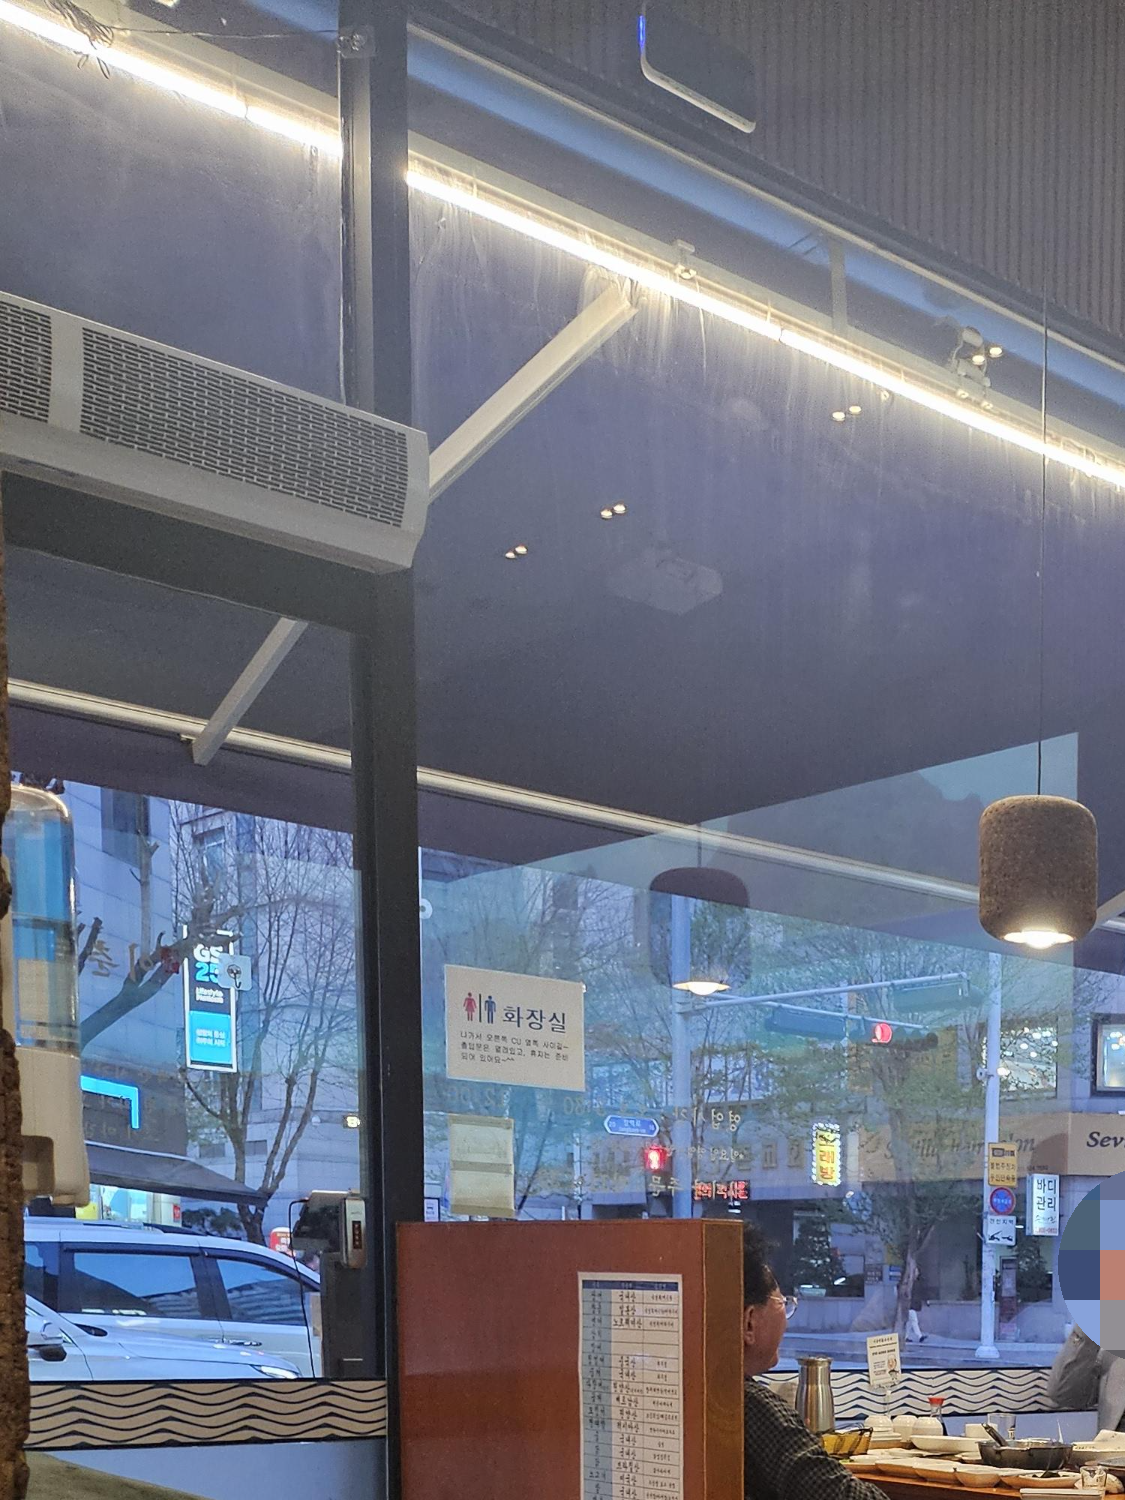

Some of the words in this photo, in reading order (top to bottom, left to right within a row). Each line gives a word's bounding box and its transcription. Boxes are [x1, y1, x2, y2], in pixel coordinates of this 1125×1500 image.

[194, 943, 223, 963] GS
[503, 1006, 566, 1034] 화장실
[460, 1031, 482, 1040] 나가서
[487, 1034, 508, 1043] 오른쪽
[511, 1037, 522, 1045] CU
[461, 1052, 476, 1062] 되어
[530, 1050, 551, 1060] 휴지는
[555, 1053, 569, 1062] 준비
[1036, 1179, 1057, 1194] 바디
[1036, 1196, 1057, 1212] 관리
